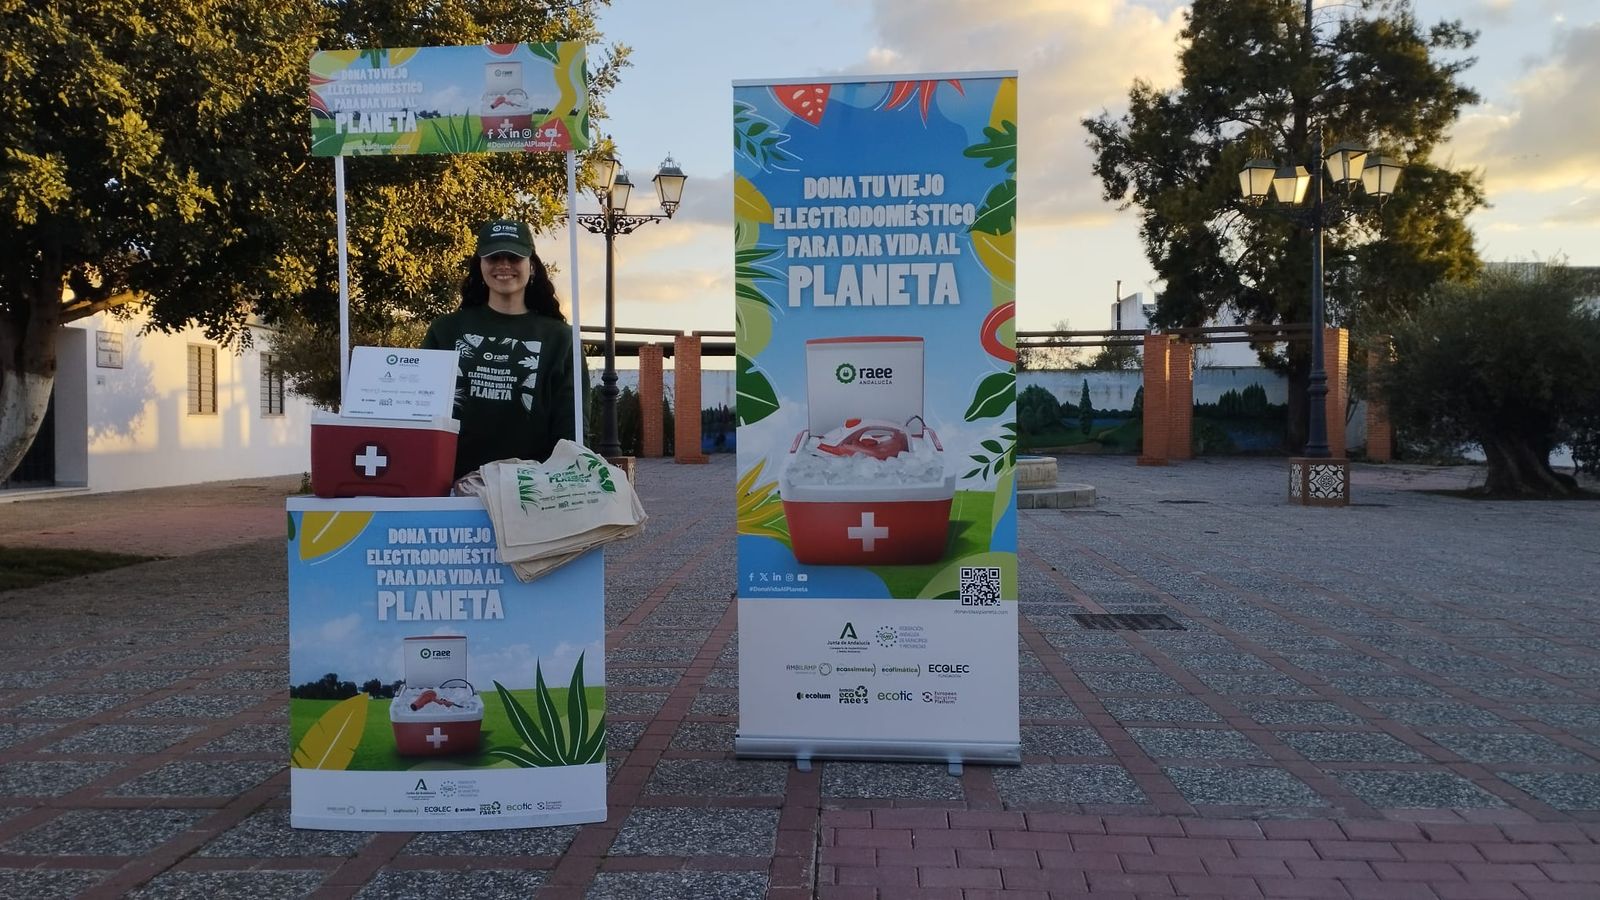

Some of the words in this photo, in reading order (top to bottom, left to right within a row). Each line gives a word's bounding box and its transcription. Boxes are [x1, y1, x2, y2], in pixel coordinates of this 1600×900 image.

[340, 68, 366, 80] DONA
[368, 68, 380, 80] TU
[381, 68, 408, 80] VIEJO
[335, 110, 417, 134] PLANETA
[804, 176, 856, 200] DONA
[859, 175, 885, 198] TU
[887, 173, 945, 197] VIEJO
[773, 199, 976, 230] ELECTRODOMÉSTICO
[787, 235, 840, 258] PARA
[842, 234, 883, 257] DAR
[885, 233, 934, 256] VIDA
[934, 232, 961, 255] AL
[788, 262, 961, 307] PLANETA
[859, 368, 892, 378] raee
[470, 386, 512, 400] PLANETA
[388, 528, 427, 545] DONA
[429, 528, 448, 544] TU
[450, 527, 491, 544] VIEJO
[377, 570, 416, 586] PARA
[417, 569, 448, 585] DAR
[448, 569, 484, 585] VIDA
[484, 568, 504, 584] AL
[378, 589, 505, 621] PLANETA
[928, 664, 970, 673] ECOLEC
[878, 691, 912, 701] ecotic
[506, 802, 532, 811] ecotic
